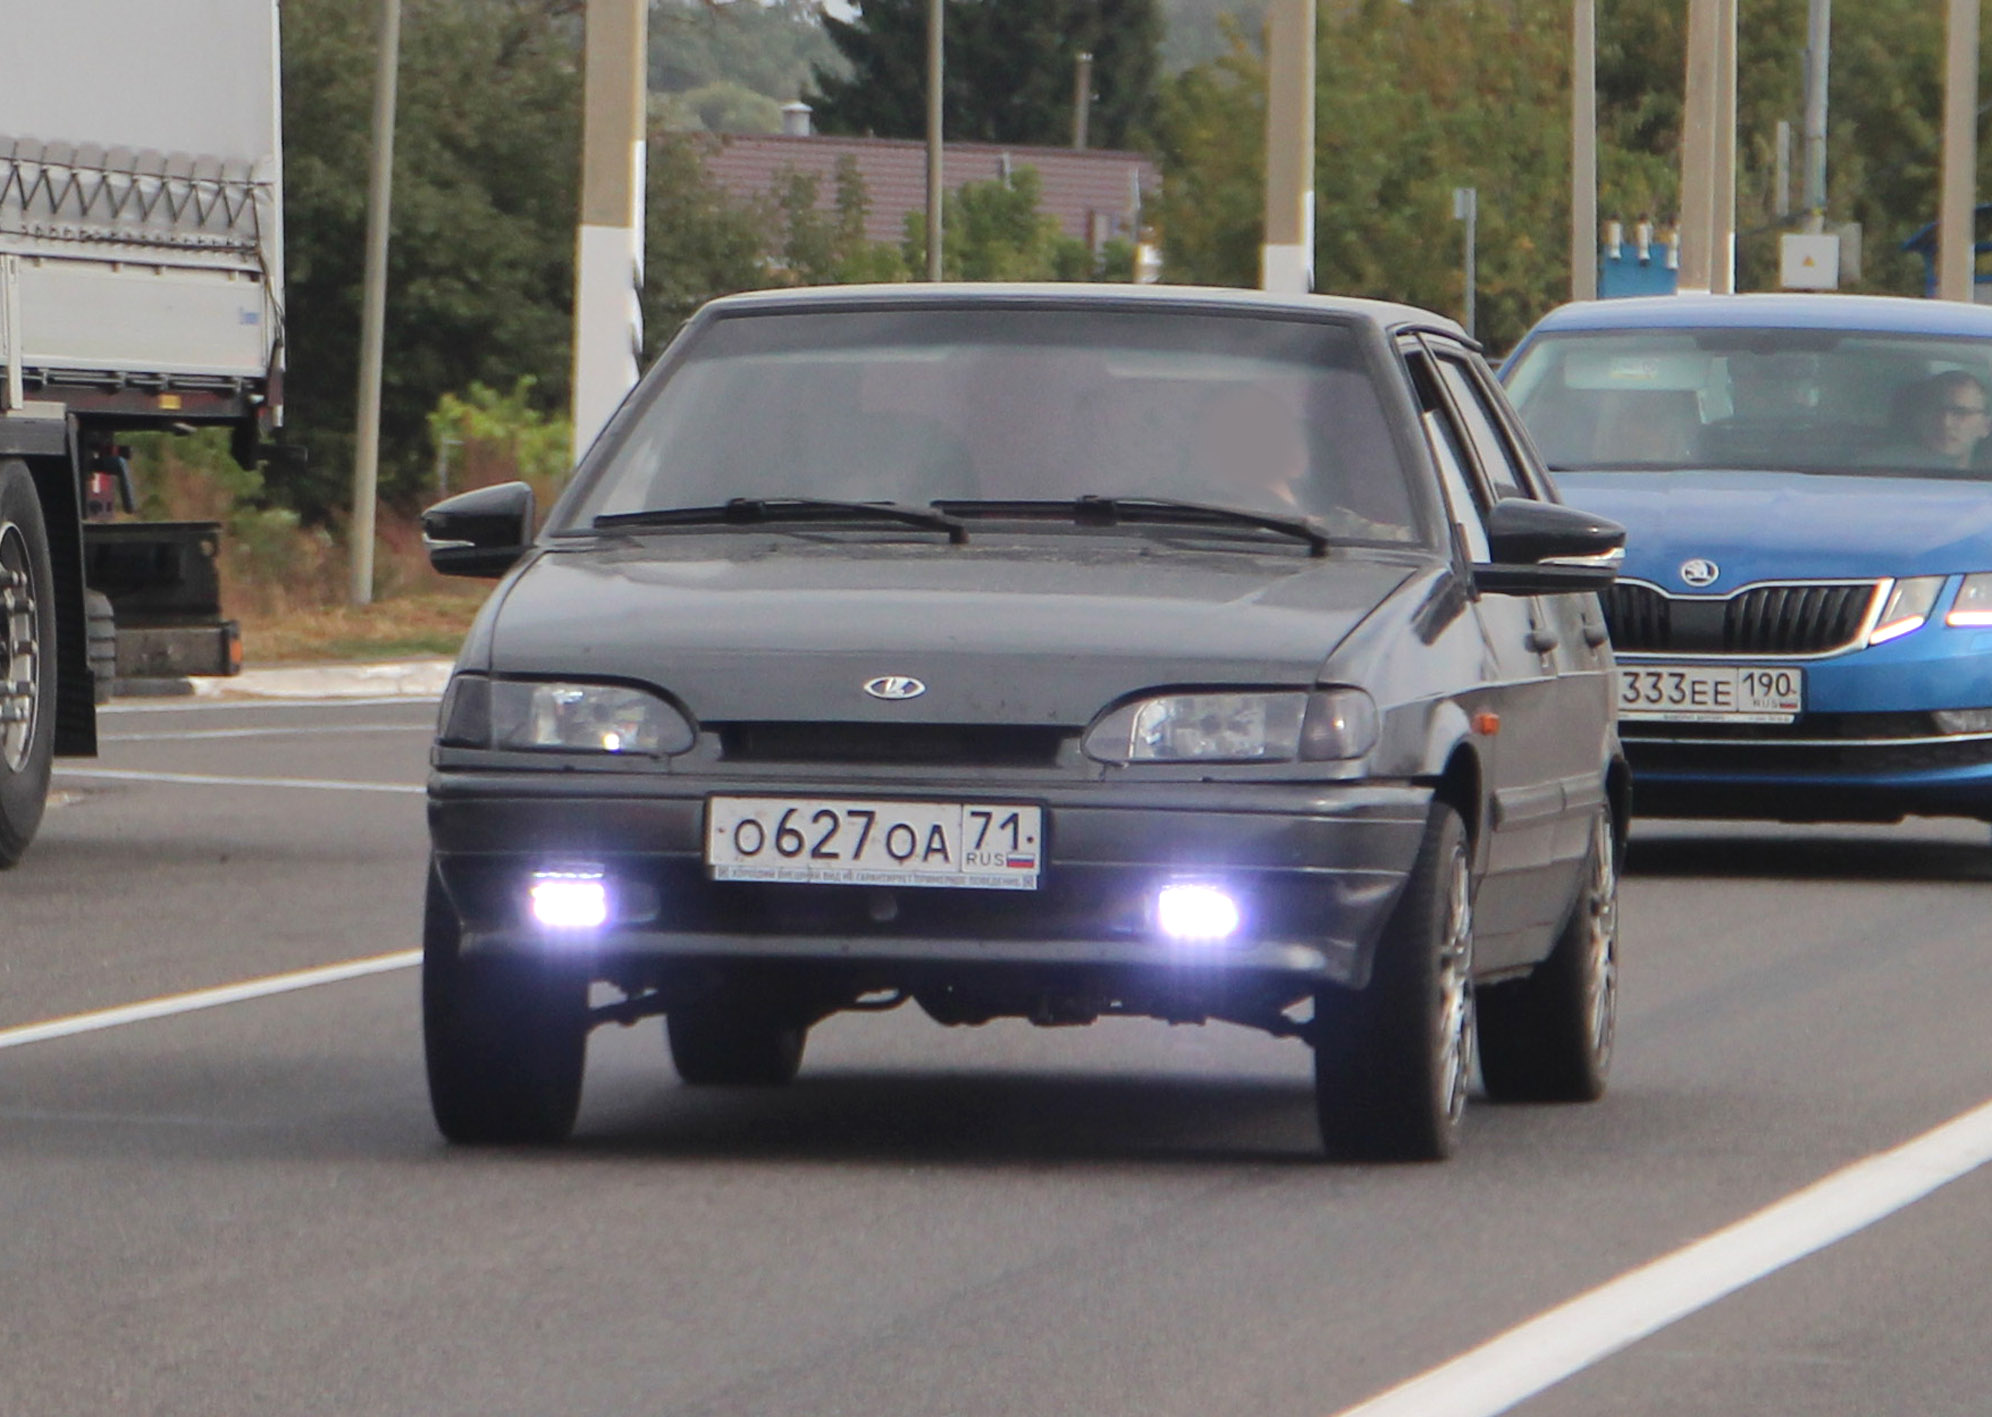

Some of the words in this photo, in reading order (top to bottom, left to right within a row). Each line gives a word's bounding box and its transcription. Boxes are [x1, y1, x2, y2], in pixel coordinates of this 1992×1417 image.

[1622, 671, 1731, 705] 333EE
[1743, 672, 1791, 697] 190
[734, 808, 951, 863] O627OA
[970, 811, 1019, 851] 71
[966, 852, 1004, 866] RUS
